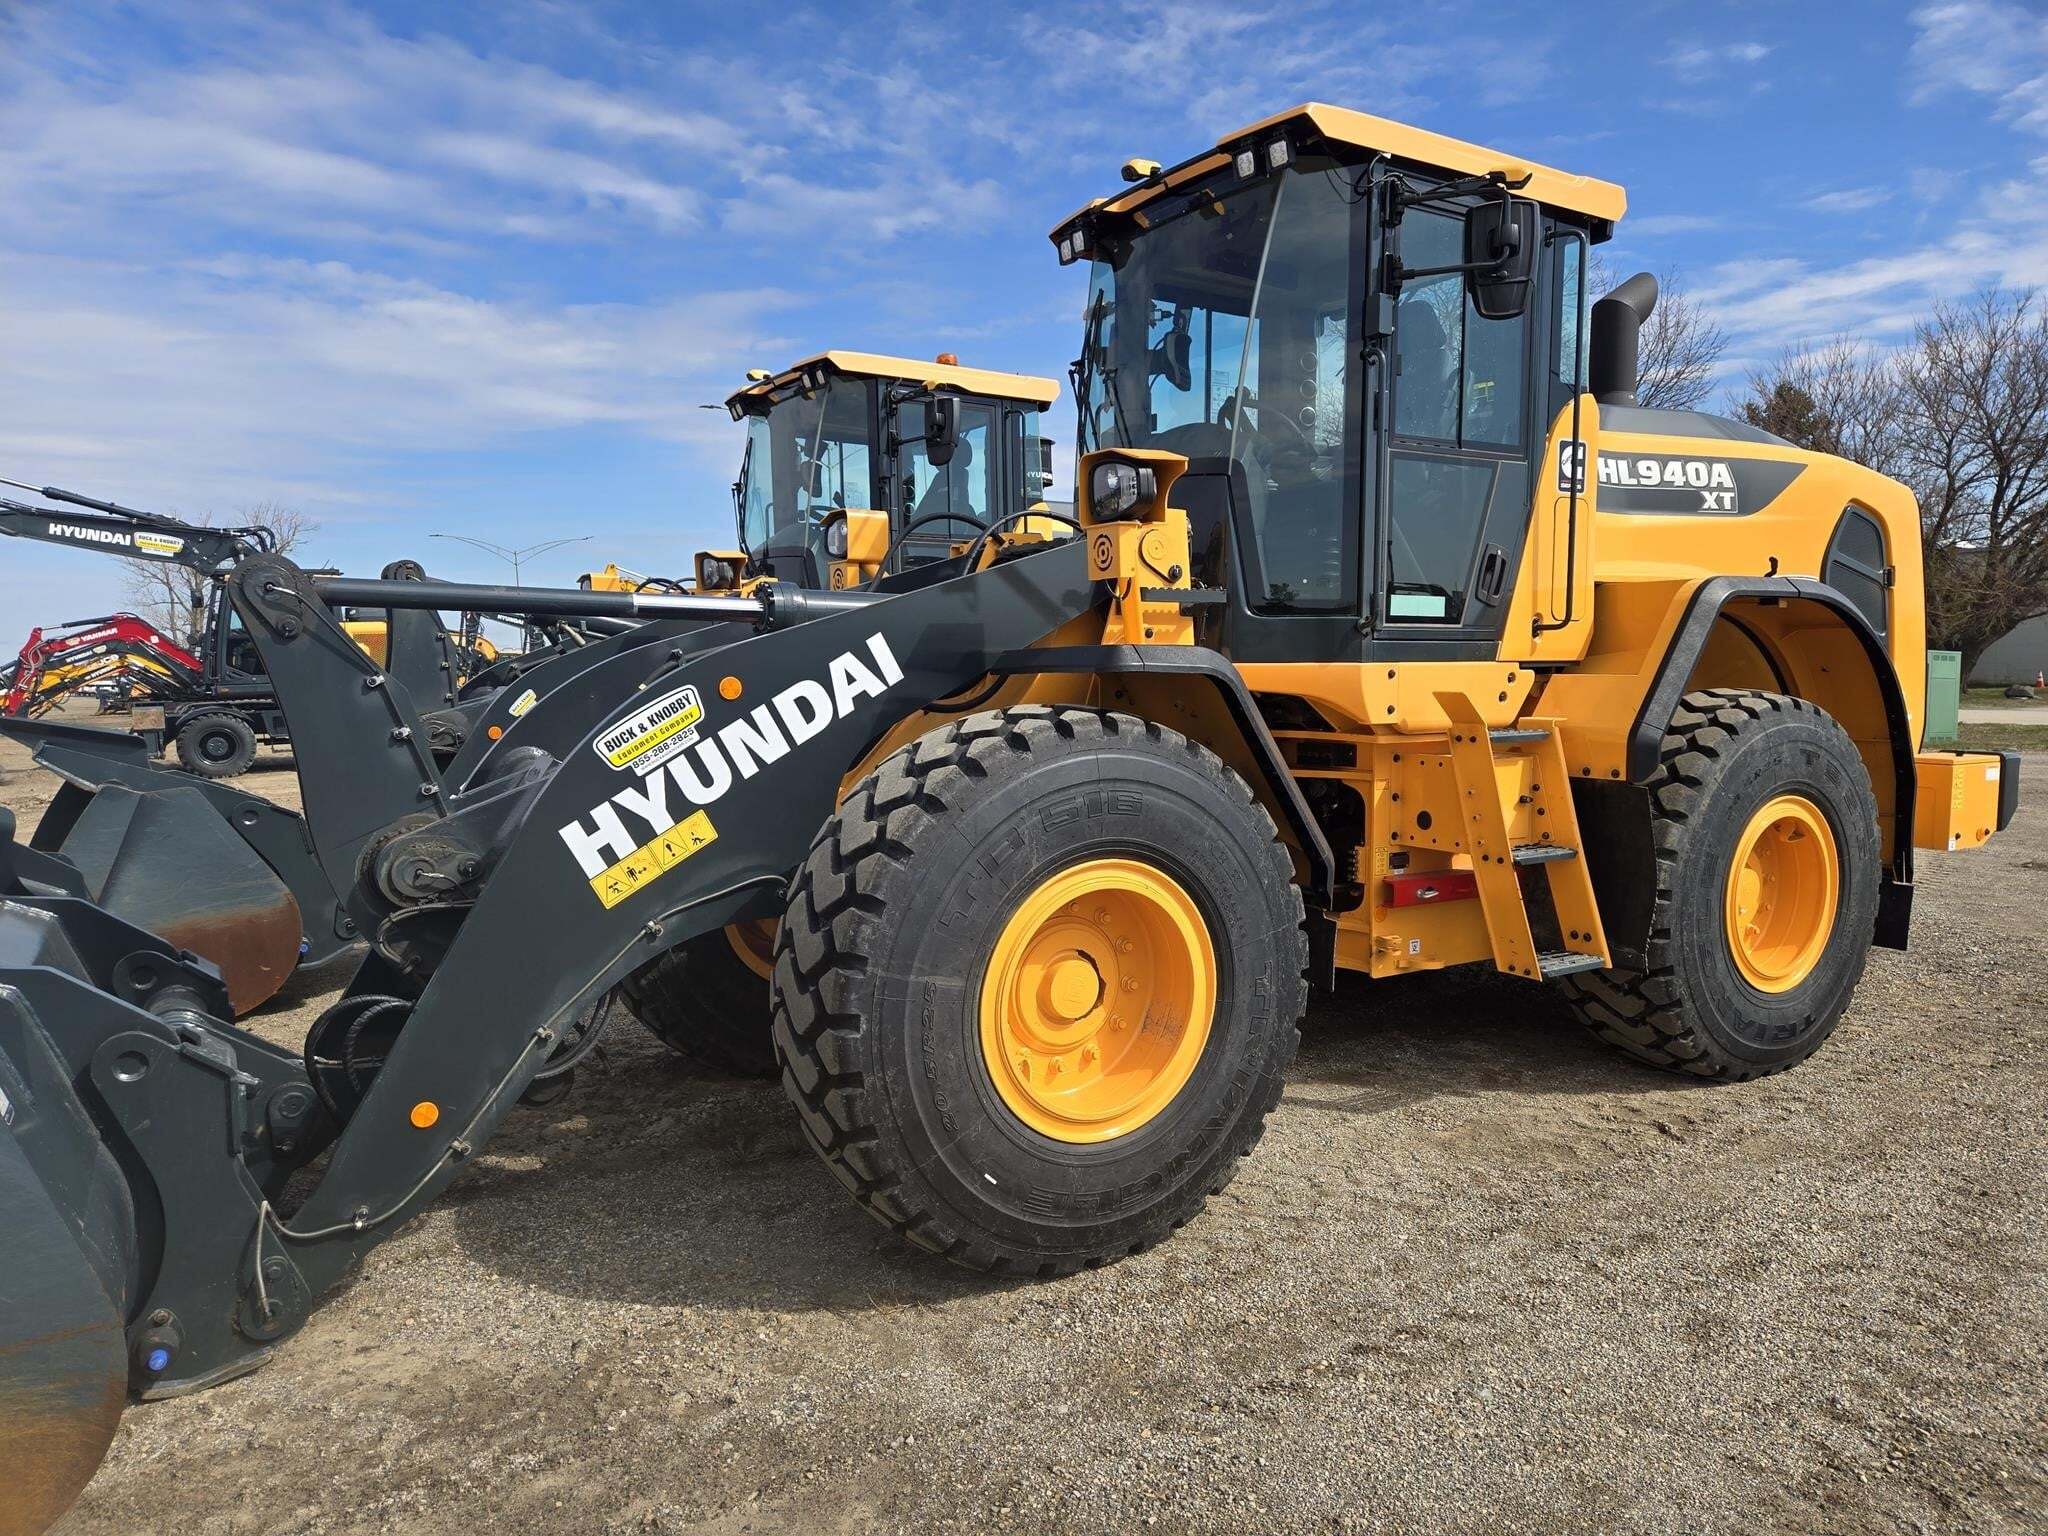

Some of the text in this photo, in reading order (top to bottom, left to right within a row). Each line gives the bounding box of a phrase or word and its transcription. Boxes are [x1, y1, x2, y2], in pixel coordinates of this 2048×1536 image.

[1597, 457, 1734, 488] HL940A
[1700, 491, 1735, 511] XT
[49, 523, 131, 546] HYUNDAI
[603, 693, 693, 753] BUCK & KNOBBY
[617, 733, 658, 761] Equipment
[660, 710, 694, 735] Company
[558, 631, 905, 879] HYUNDAI
[632, 727, 695, 769] 855-288-2825
